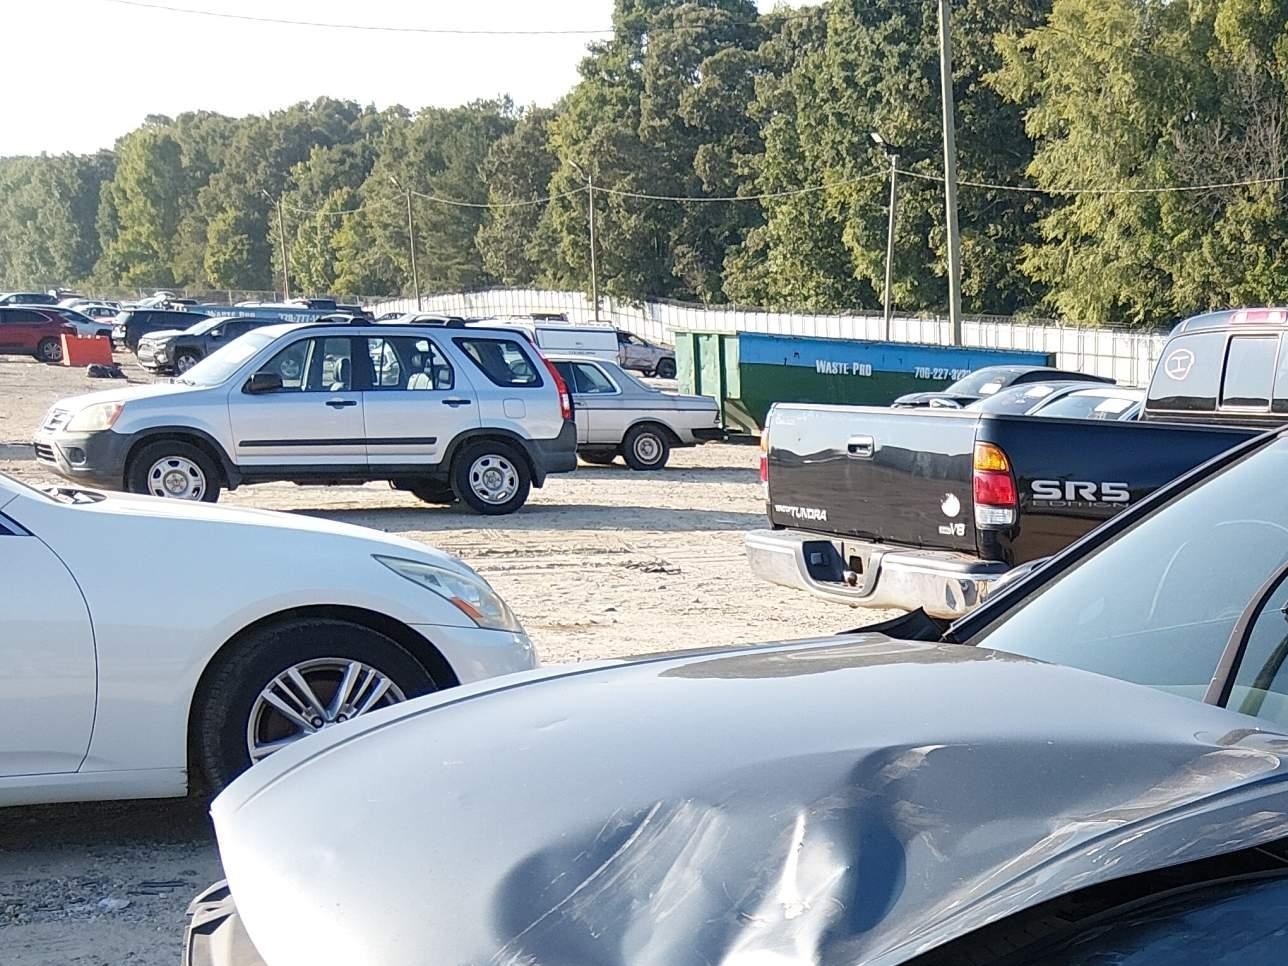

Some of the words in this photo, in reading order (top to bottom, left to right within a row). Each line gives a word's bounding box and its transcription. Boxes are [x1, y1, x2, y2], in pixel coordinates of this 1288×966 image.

[815, 359, 849, 375] WASTE
[852, 361, 872, 377] PRO
[1030, 480, 1131, 502] SR5
[1032, 500, 1130, 508] EDITION
[790, 506, 828, 521] TUNDRA
[950, 522, 966, 537] V8
